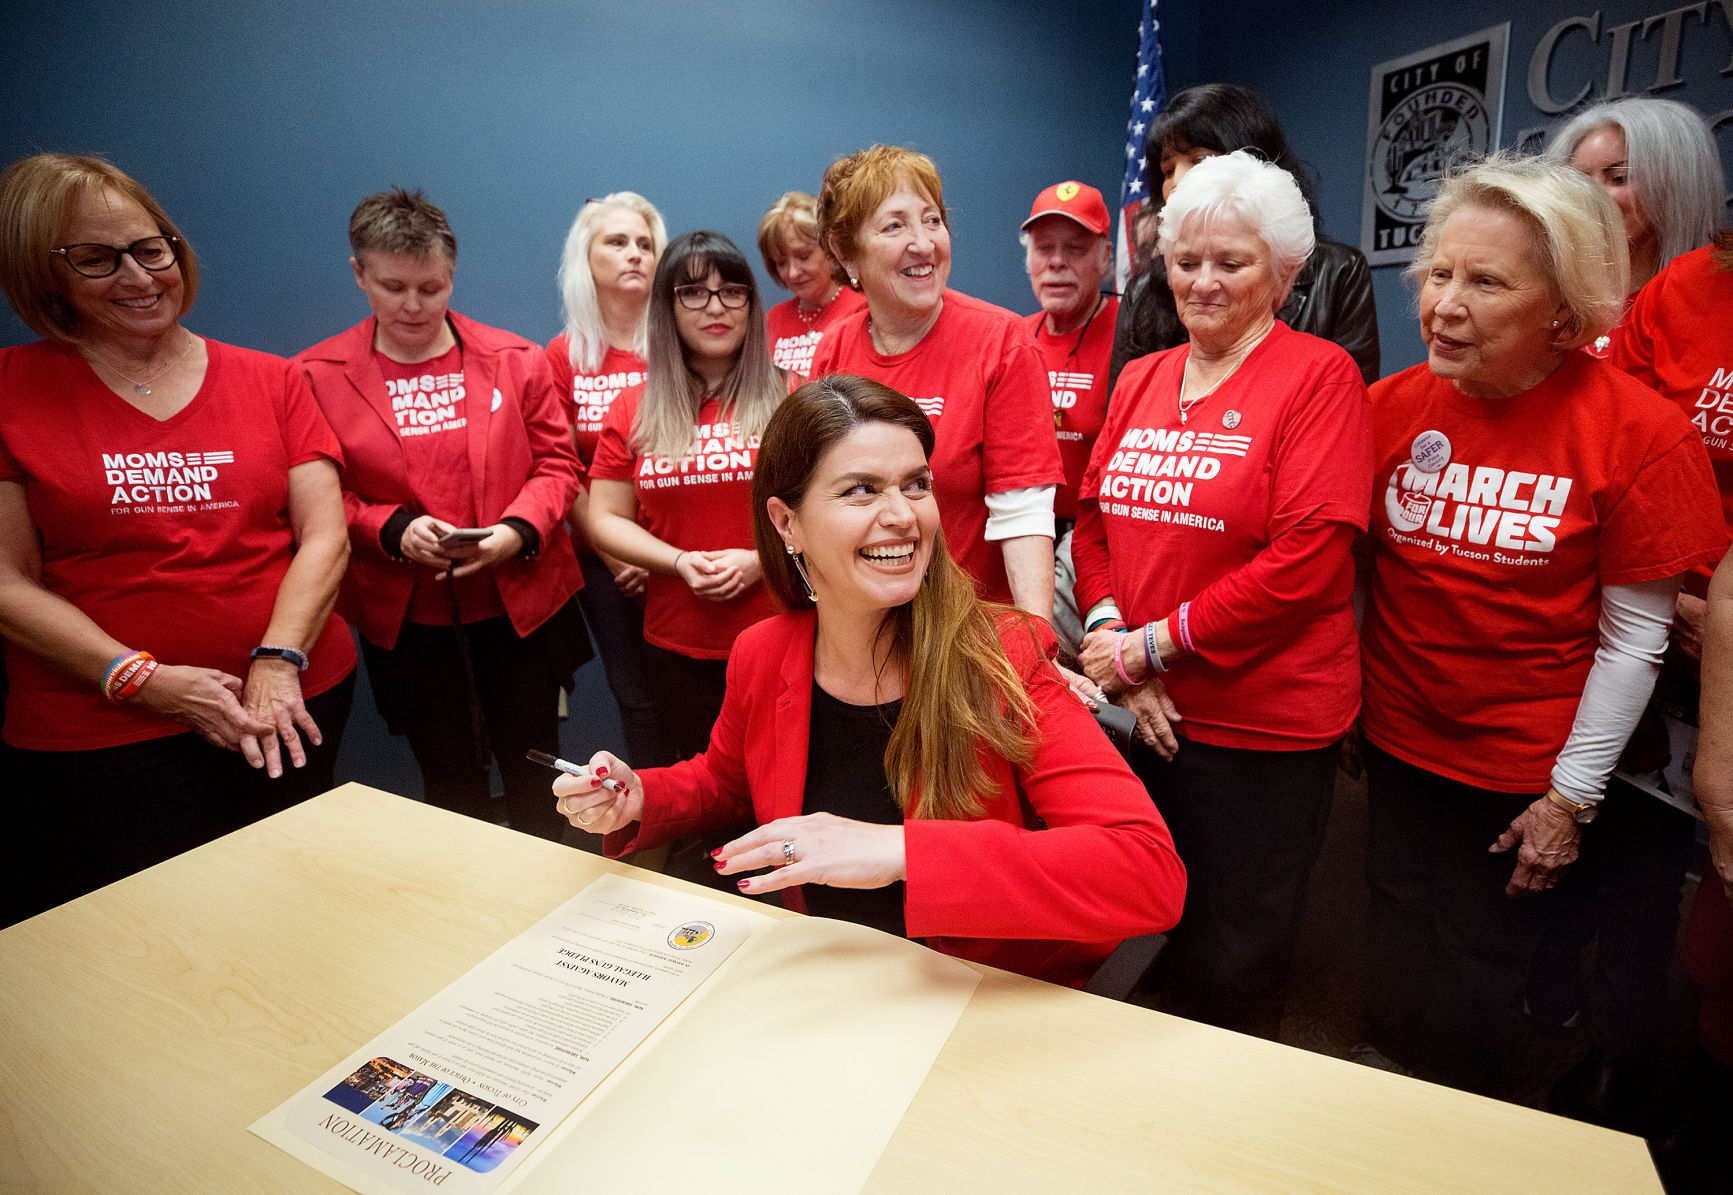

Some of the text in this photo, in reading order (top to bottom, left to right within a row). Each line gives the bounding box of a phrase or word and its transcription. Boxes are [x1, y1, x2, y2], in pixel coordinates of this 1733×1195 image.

[1390, 49, 1482, 93] CITY OF
[1381, 90, 1481, 141] FOUNDED
[1379, 222, 1424, 249] TUC
[385, 374, 436, 396] OMS
[574, 372, 643, 390] MOMS
[392, 385, 466, 411] MAND
[574, 389, 621, 406] DEM
[395, 405, 455, 426] TION
[400, 426, 430, 437] SENSE
[431, 424, 441, 433] IN
[693, 422, 730, 439] MS
[1056, 431, 1083, 441] MERICA
[1119, 429, 1195, 453] MOMS
[1415, 440, 1444, 463] SAFER
[1703, 436, 1728, 449] GUN
[102, 452, 185, 469] MOMS
[640, 450, 751, 477] ACTION
[1107, 451, 1221, 480] DEMAND
[105, 466, 218, 485] DEMAND
[640, 480, 655, 489] FOR
[657, 477, 680, 488] GUN
[683, 473, 719, 485] SENSE
[722, 472, 733, 482] IN
[111, 483, 212, 504] ACTION
[1099, 475, 1193, 507] ACTION
[1402, 462, 1573, 516] MARCH
[111, 500, 239, 515] FOR GUN SENSE IN AMERICA
[1112, 504, 1130, 517] GUN
[1131, 506, 1160, 522] SENSE
[1161, 511, 1172, 523] IN
[1172, 512, 1225, 532] AMERICA
[1401, 510, 1424, 523] OUR
[1406, 502, 1426, 514] FOR
[1426, 500, 1561, 553] LIVES
[1388, 528, 1550, 567] Organized by Tucson Students
[120, 659, 145, 683] DEMA
[555, 960, 591, 976] AGAINST
[556, 947, 652, 981] ILLEGAL GUNS PLEDGE
[593, 971, 630, 987] MAYORS
[479, 1082, 503, 1096] TUCSON
[512, 1095, 528, 1107] CITY
[318, 1113, 453, 1186] PROCLAMATION
